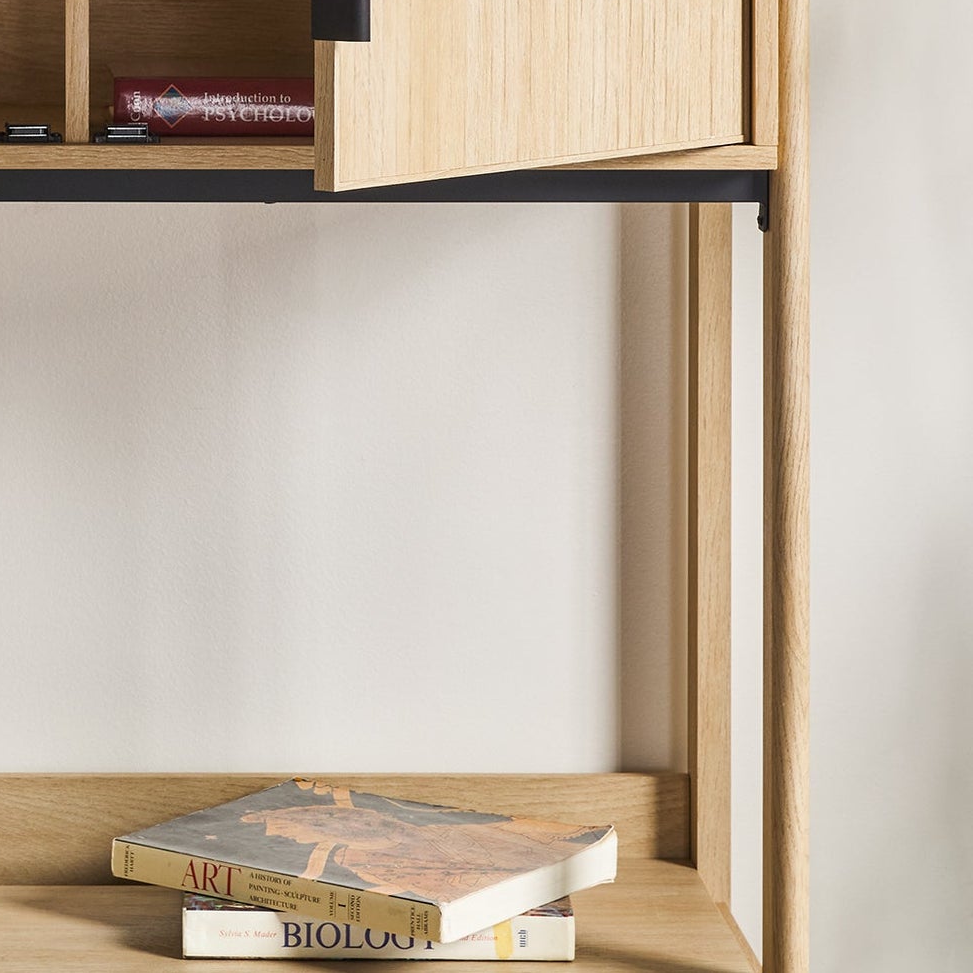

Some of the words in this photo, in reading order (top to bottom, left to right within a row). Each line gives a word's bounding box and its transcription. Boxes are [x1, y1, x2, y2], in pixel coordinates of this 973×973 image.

[203, 92, 277, 105] Introduction
[279, 93, 292, 104] to
[202, 107, 315, 123] PSYCHOLO
[181, 858, 242, 898] ART
[255, 873, 283, 885] HISTORY
[282, 879, 292, 887] OF
[248, 883, 281, 896] PAINTING
[283, 890, 322, 904] SCULPTURE
[249, 894, 298, 911] ARCHITECTURE
